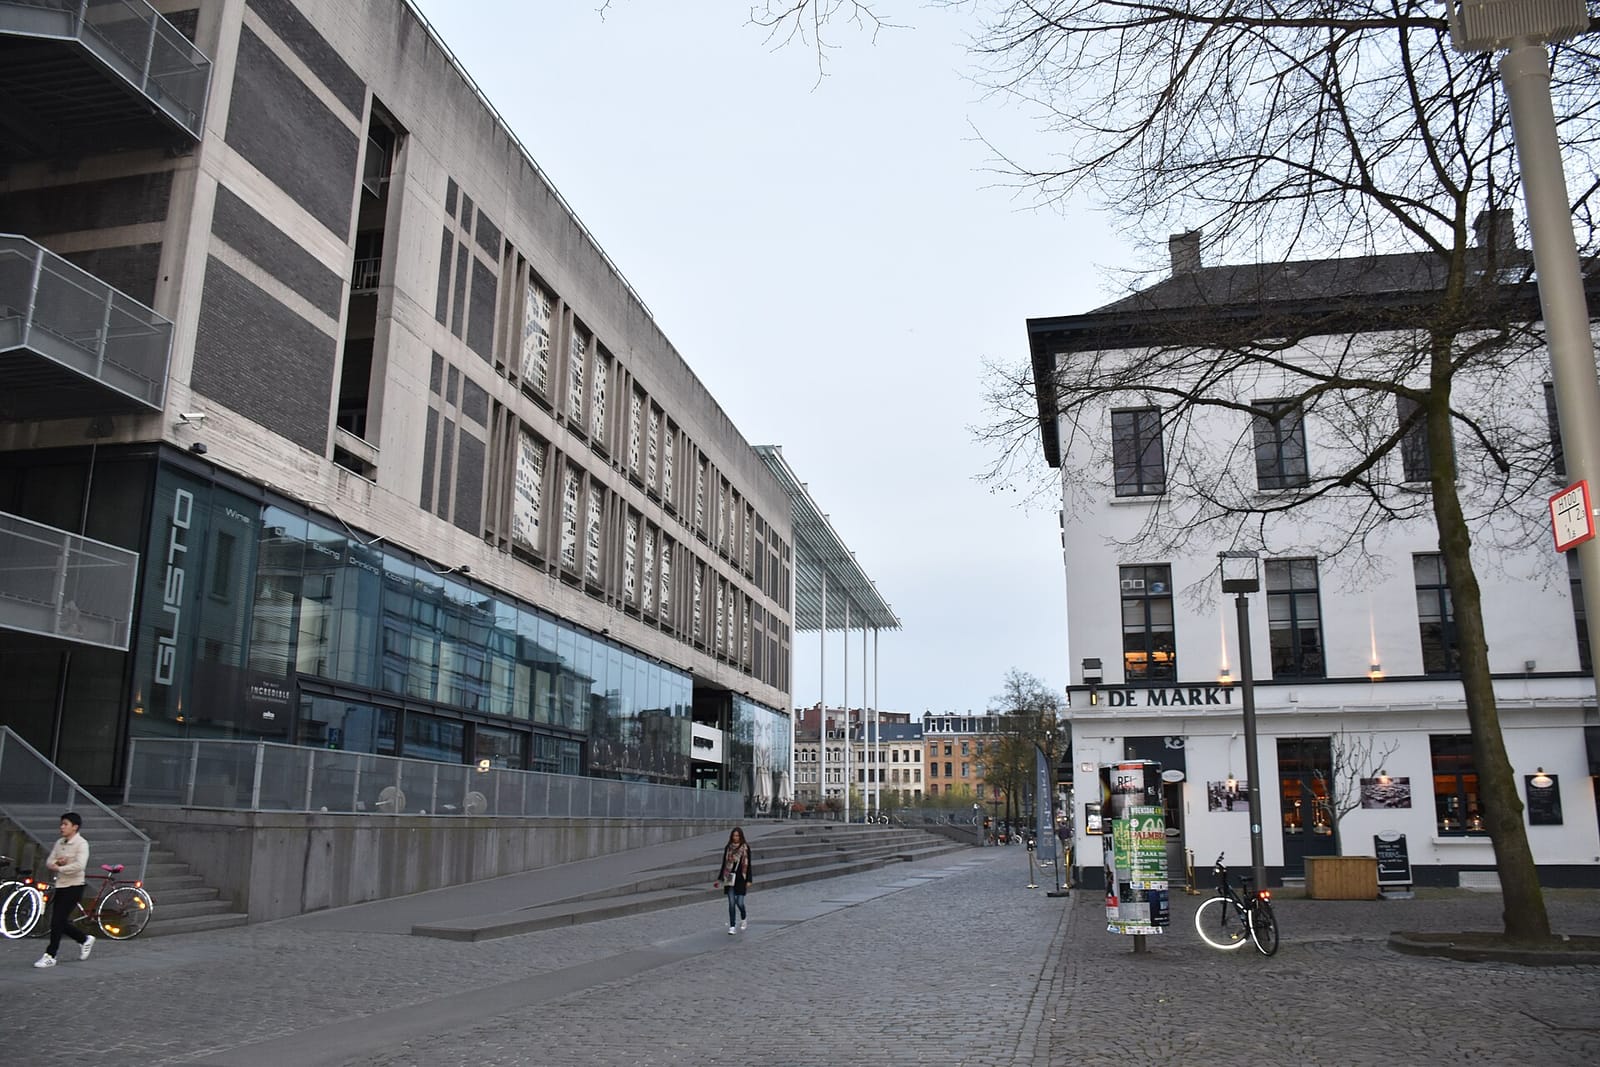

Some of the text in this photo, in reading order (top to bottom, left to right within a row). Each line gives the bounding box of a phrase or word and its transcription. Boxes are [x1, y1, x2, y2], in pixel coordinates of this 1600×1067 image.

[225, 506, 251, 524] Wine
[312, 541, 341, 561] Eating
[348, 556, 380, 577] Drinking
[154, 487, 194, 686] GUSTO
[1108, 687, 1235, 707] DE MARKT
